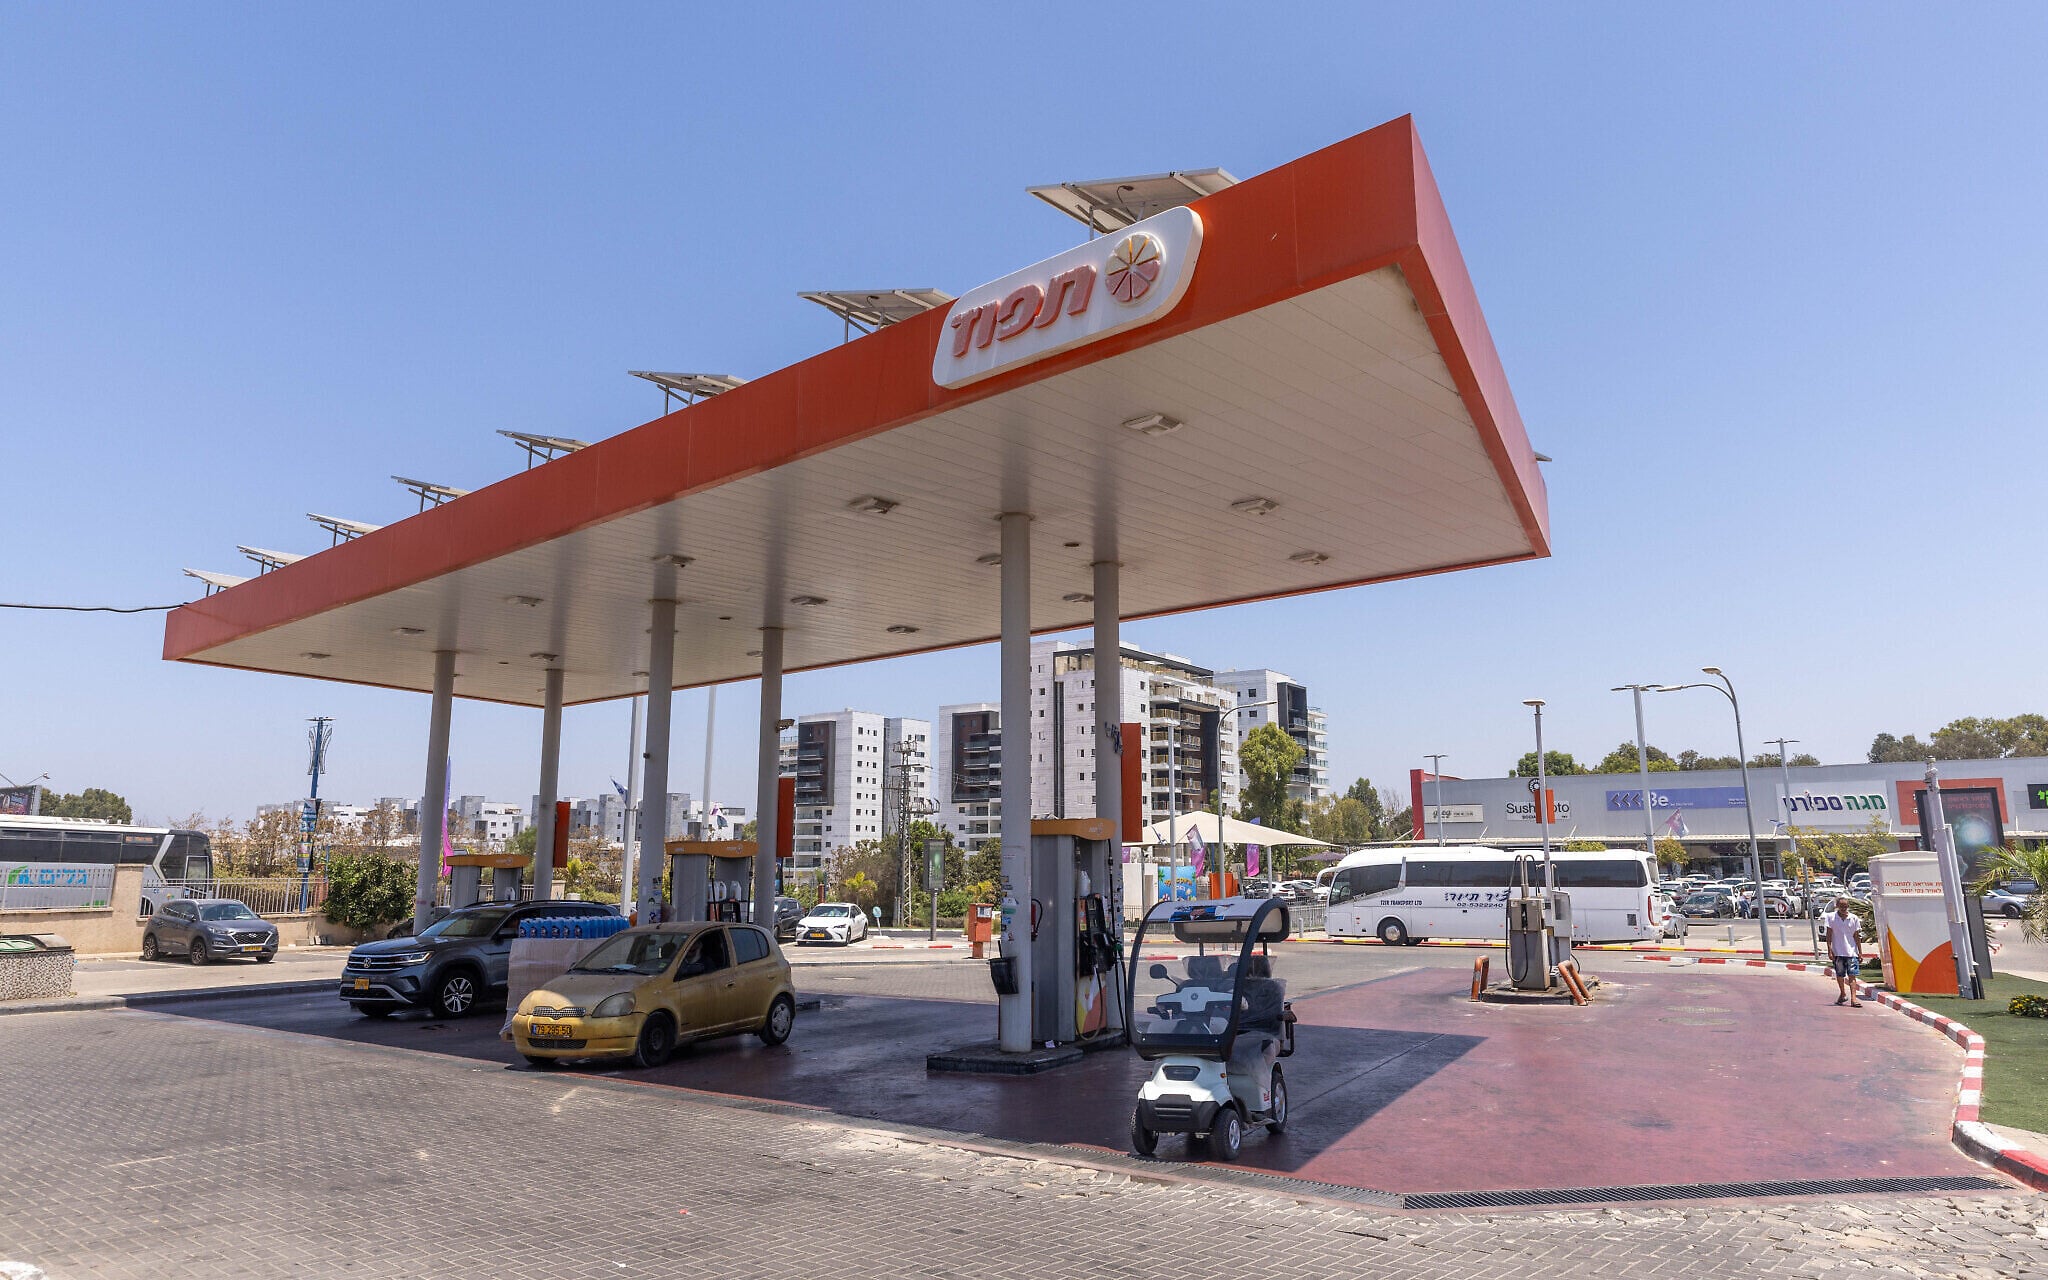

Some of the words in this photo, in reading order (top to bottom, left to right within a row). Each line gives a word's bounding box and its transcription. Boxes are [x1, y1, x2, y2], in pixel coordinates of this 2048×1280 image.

[951, 264, 1097, 358] תפוז
[1844, 794, 1887, 811] מגה
[38, 869, 87, 885] גלים
